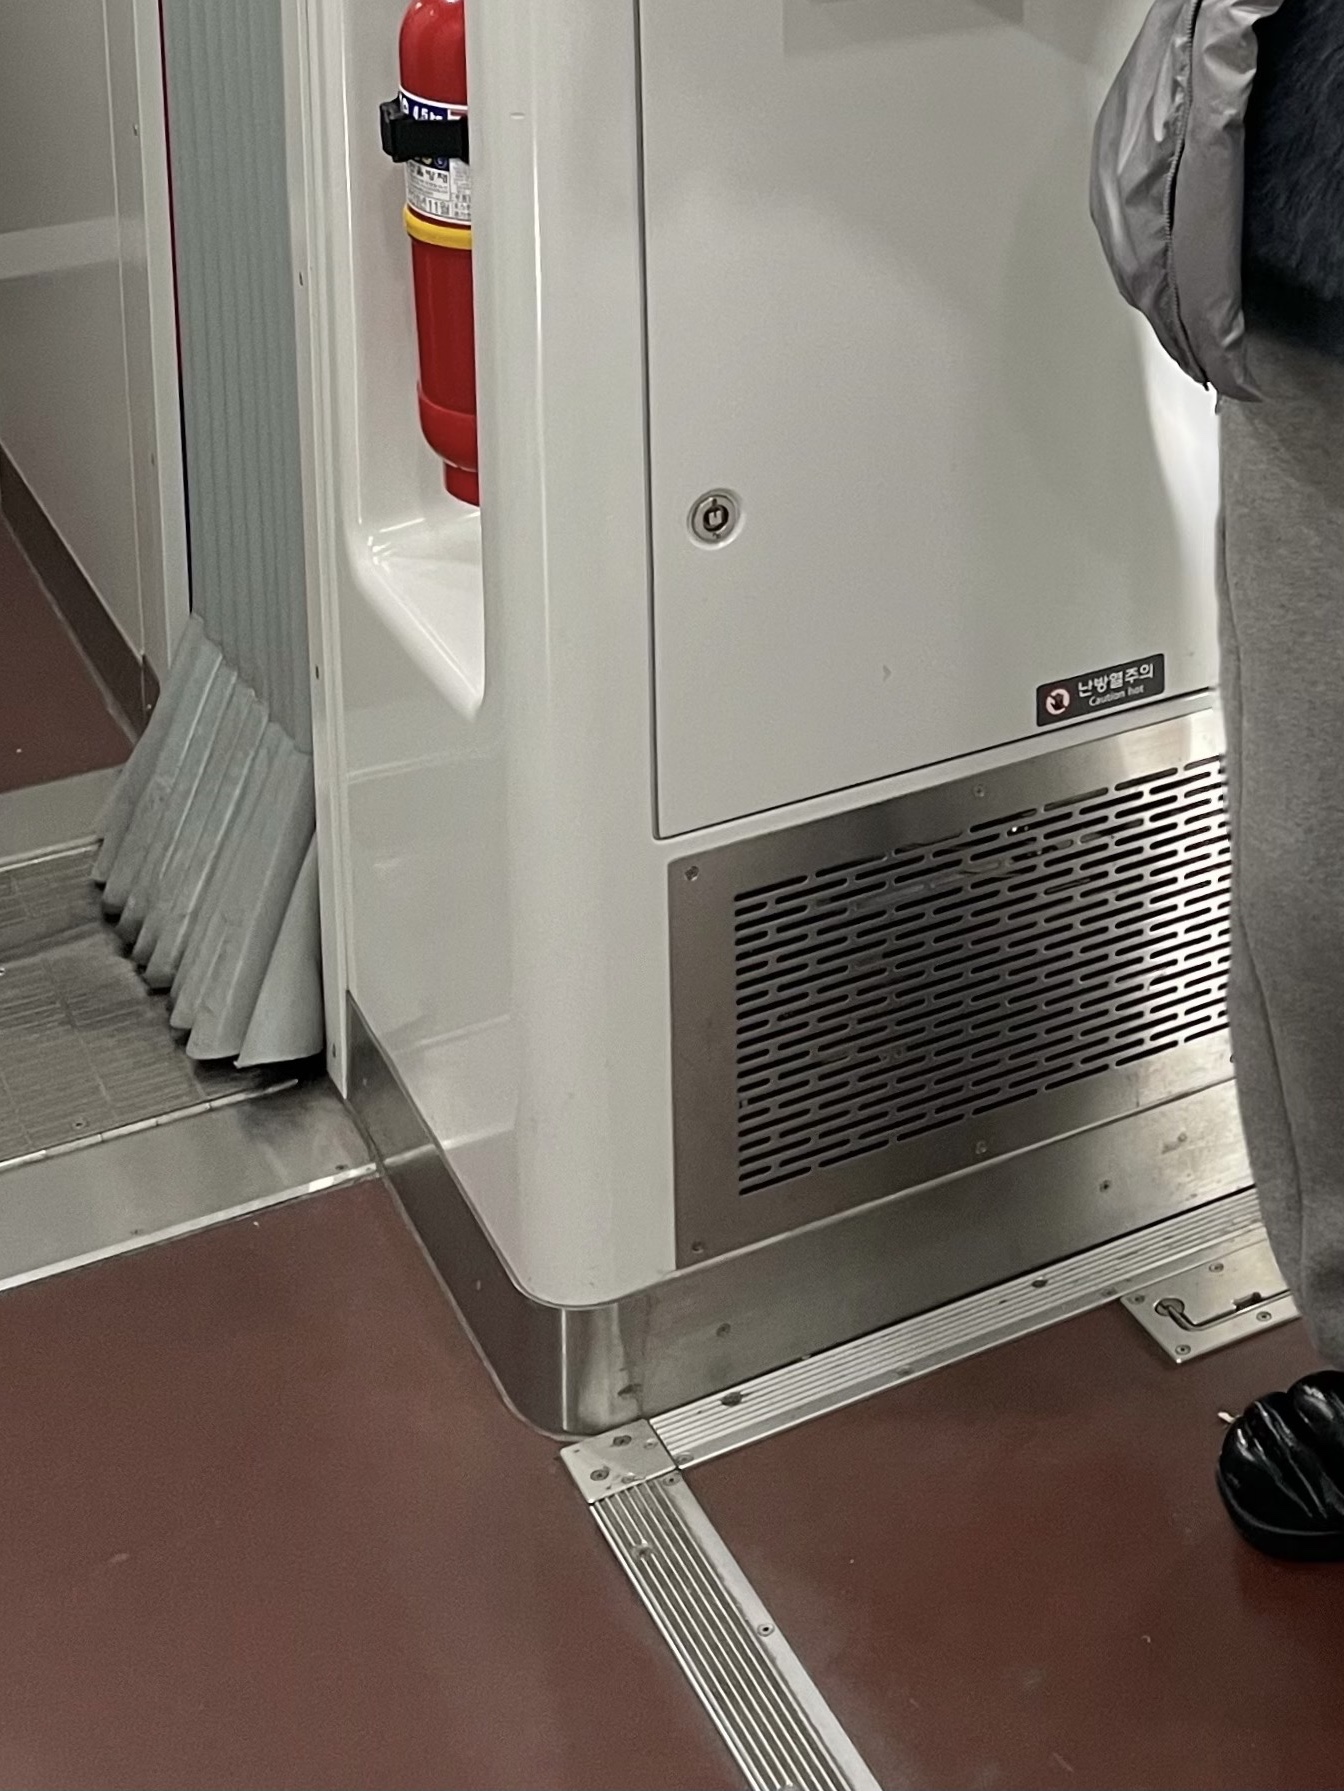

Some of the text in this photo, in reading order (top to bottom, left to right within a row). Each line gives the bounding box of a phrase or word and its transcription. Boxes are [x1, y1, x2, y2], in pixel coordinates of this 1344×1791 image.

[1078, 663, 1153, 697] 난방열주의
[1089, 685, 1144, 706] Caution hot
